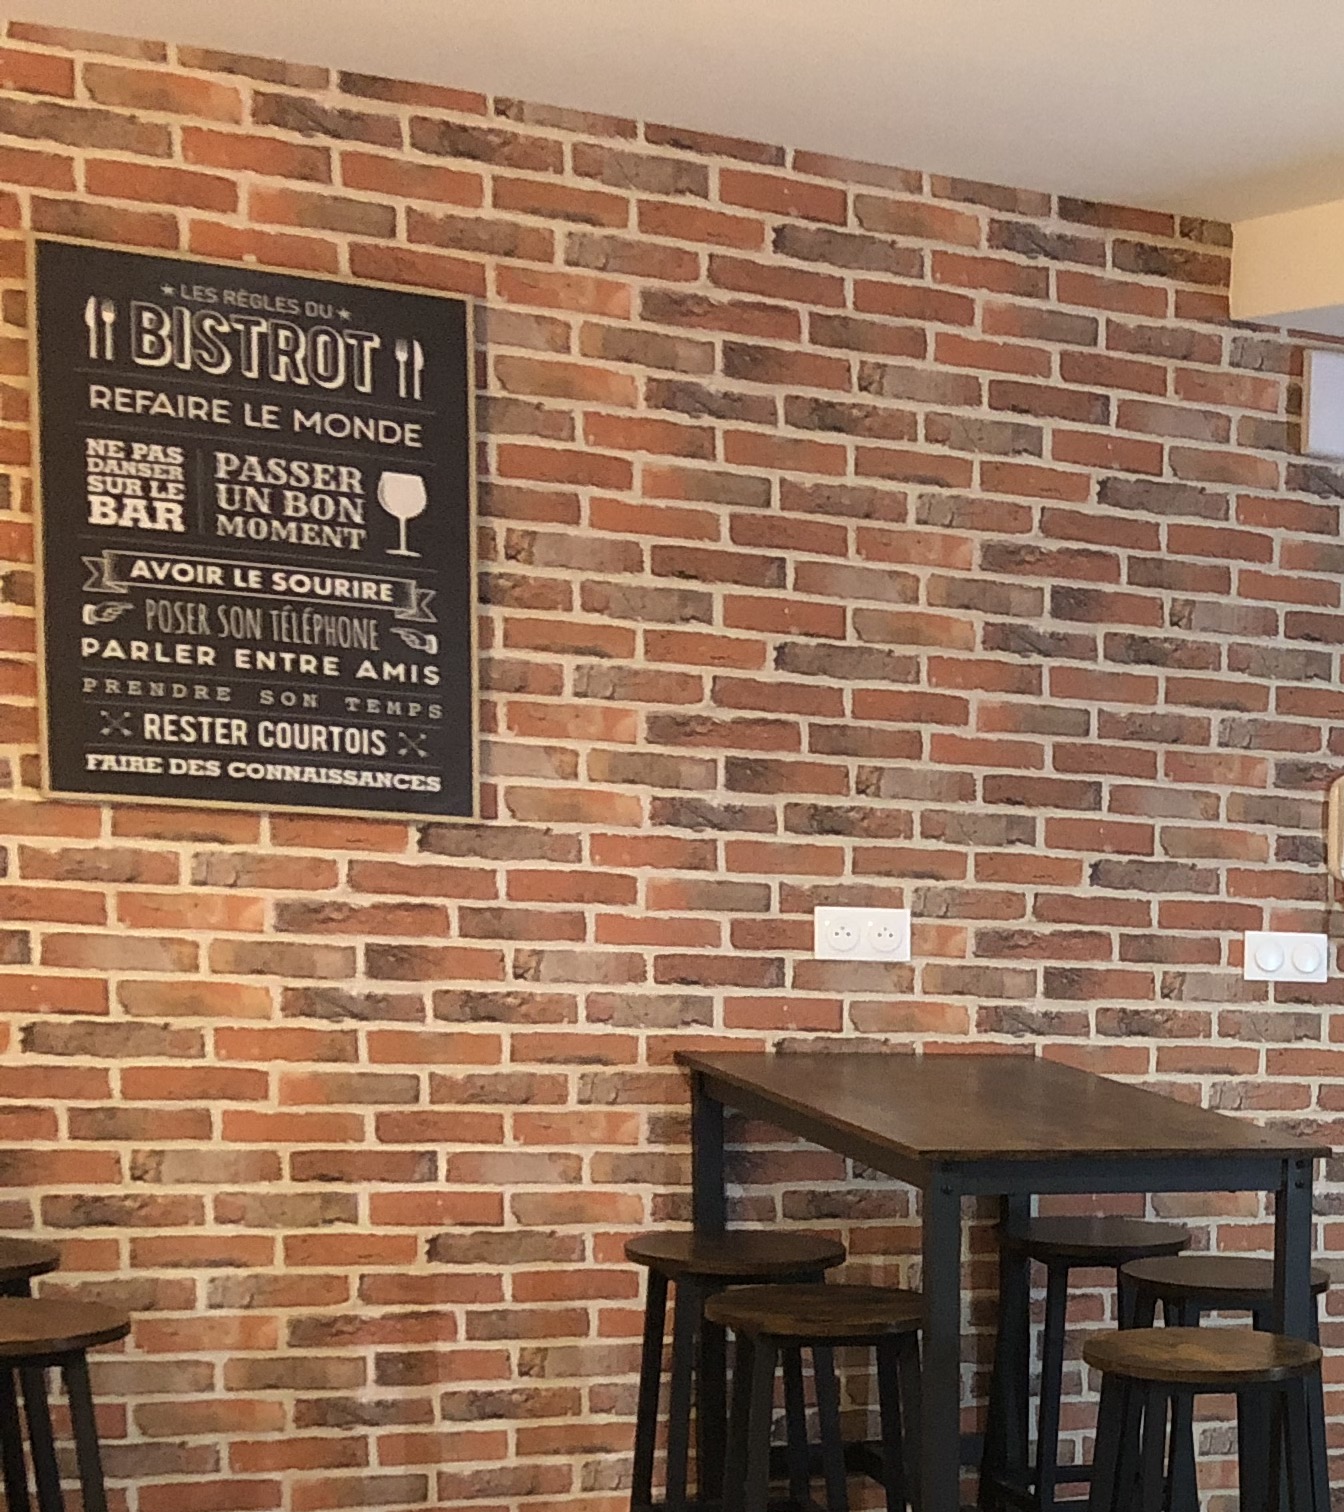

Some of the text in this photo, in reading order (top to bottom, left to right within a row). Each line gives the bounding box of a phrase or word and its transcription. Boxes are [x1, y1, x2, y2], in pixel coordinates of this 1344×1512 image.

[180, 284, 333, 319] LES RÈGLES DU
[131, 301, 381, 394] BISTROT
[89, 384, 423, 448] REFAIRE LE MONDE
[86, 437, 184, 465] NE PAS
[86, 456, 185, 482] DANSER
[87, 474, 186, 500] SUR LE
[213, 451, 366, 495] PASSER
[87, 494, 186, 533] BAR
[215, 483, 366, 525] UN BON
[215, 514, 368, 550] MOMENT
[130, 559, 394, 602] AVOIR LE SOURIRE
[145, 598, 381, 651] POSER SON TÉLÉPHONE
[80, 637, 441, 686] PARLER ENTRE AMIS
[81, 677, 443, 719] PRENDRE SON TEMPS
[143, 713, 387, 757] RESTER COURTOIS
[85, 753, 442, 792] FAIRE DES CONNAISSANCES
